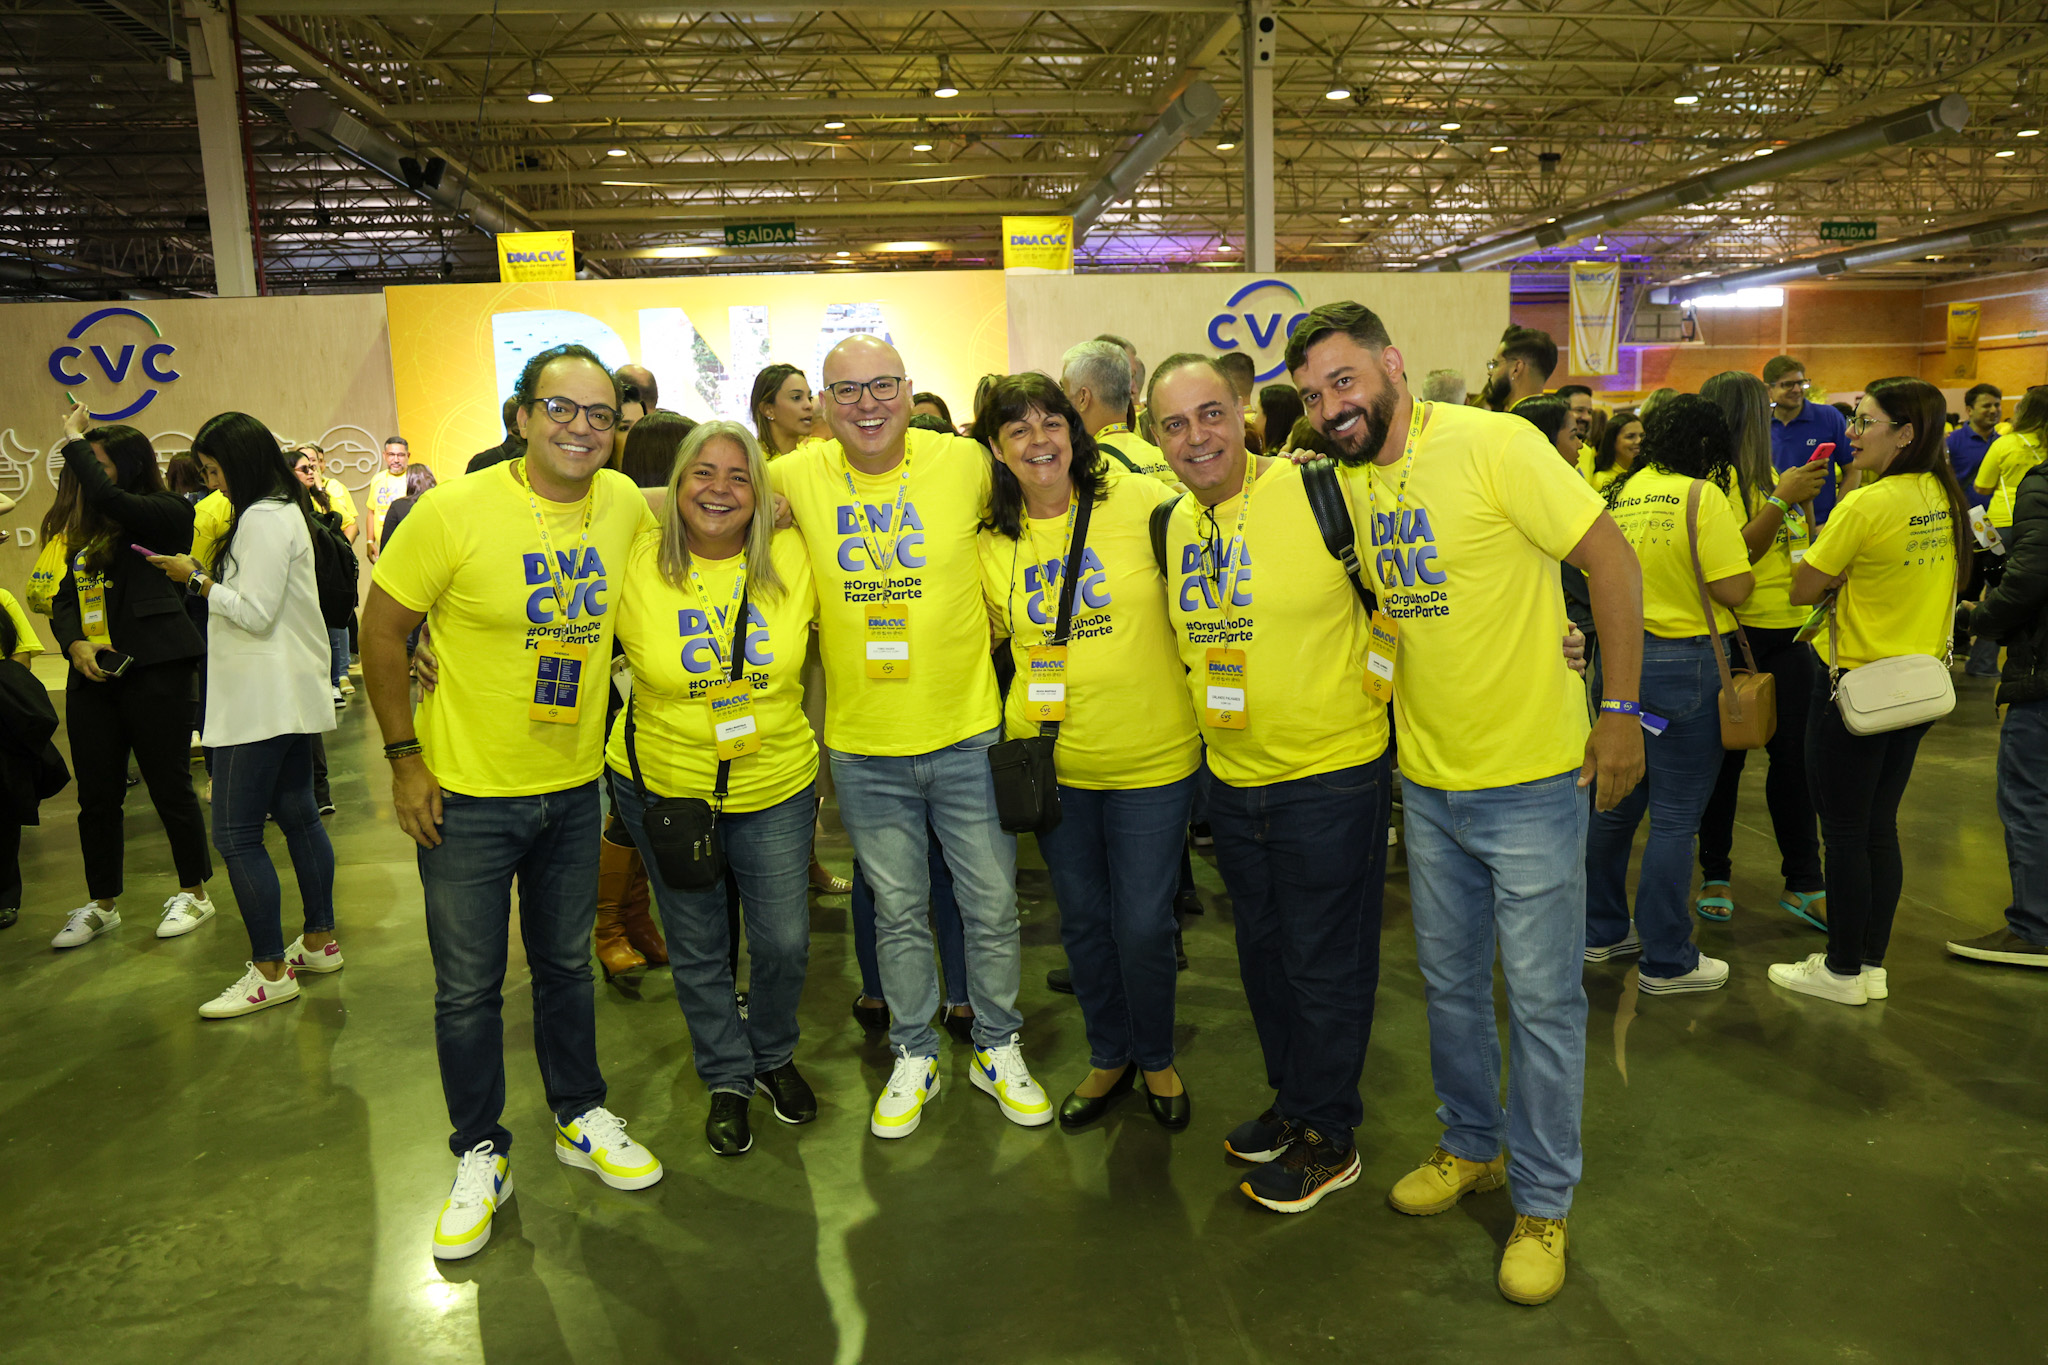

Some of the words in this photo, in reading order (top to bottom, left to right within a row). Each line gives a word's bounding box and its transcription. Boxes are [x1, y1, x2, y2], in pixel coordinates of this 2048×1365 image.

[736, 226, 786, 243] SAÍDA
[1830, 224, 1867, 238] SAÍDA
[1010, 235, 1040, 246] DNA
[1040, 234, 1067, 245] CVC
[506, 252, 538, 263] DNA
[538, 250, 566, 261] CVC
[48, 343, 182, 386] CVC
[1605, 497, 1642, 511] spírito
[1643, 493, 1680, 505] Santo
[837, 502, 924, 535] DNA
[1909, 510, 1947, 526] Espírito
[1371, 508, 1436, 547] DNA
[523, 546, 607, 586] DNA
[1024, 546, 1104, 593] DNA
[1376, 545, 1448, 587] CVC
[844, 577, 922, 592] #OrguhoDe
[1179, 568, 1253, 612] CVC
[526, 579, 608, 624] CVC
[844, 589, 922, 602] FazerParte
[1390, 591, 1448, 607] OrgulhoDe
[1390, 605, 1450, 619] azerParte
[868, 618, 887, 626] DNA
[888, 618, 906, 626] CVC
[1071, 614, 1112, 631] ulhoDe
[1186, 617, 1254, 633] #OrgulhoDe
[1071, 625, 1113, 640] rParte
[1189, 630, 1254, 644] FazerParte
[525, 633, 600, 650] FParte
[1031, 661, 1048, 669] DNA
[1049, 660, 1065, 668] CVC
[1208, 663, 1227, 672] DNA
[1227, 664, 1243, 673] CVC
[689, 672, 769, 690] #OrgoDe
[712, 698, 732, 709] DNA
[732, 693, 750, 704] CVC
